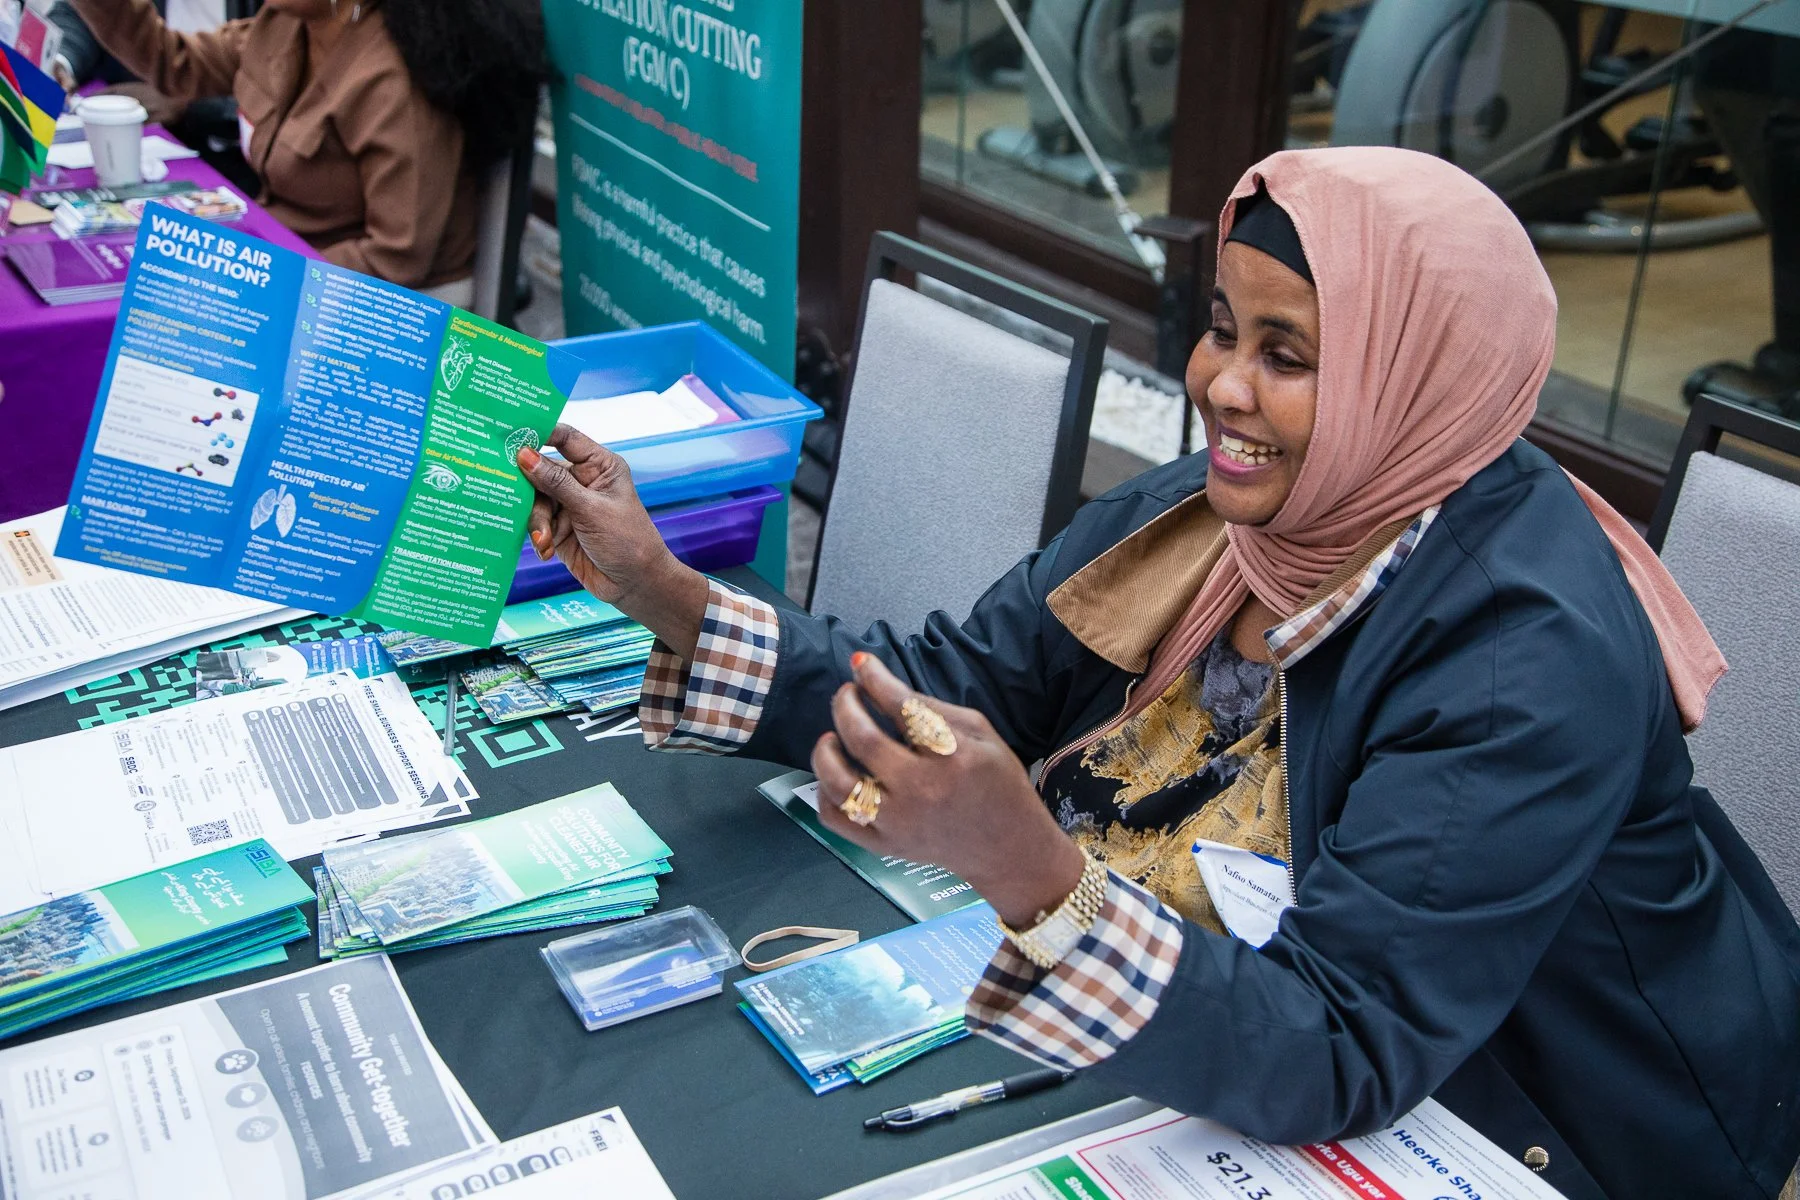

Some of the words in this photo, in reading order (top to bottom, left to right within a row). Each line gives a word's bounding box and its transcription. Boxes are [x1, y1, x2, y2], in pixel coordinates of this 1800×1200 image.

[152, 214, 215, 249] WHAT
[217, 238, 236, 257] IS
[238, 246, 272, 270] AIR
[146, 234, 270, 288] POLLUTION?
[140, 262, 188, 283] ACCORDING
[188, 277, 200, 286] TO
[201, 280, 217, 292] THE
[217, 286, 239, 298] WHO:
[724, 254, 767, 299] causes
[147, 277, 174, 291] pollution
[211, 298, 240, 312] presence
[128, 316, 180, 337] POLLUTANTS
[130, 307, 196, 333] UNDERSTANDING
[197, 328, 231, 343] CRITERIA
[232, 338, 246, 347] AIR
[450, 323, 477, 338] Diseases
[452, 316, 498, 339] Cardiovascular
[503, 337, 543, 357] Neurological
[300, 349, 318, 359] WHY
[478, 356, 491, 364] Heart
[492, 360, 512, 372] Disease
[472, 377, 497, 390] Long-term
[497, 386, 516, 398] Effects:
[516, 394, 540, 408] Increased
[473, 369, 495, 383] heartbeat,
[496, 378, 514, 390] fatigue,
[514, 386, 537, 398] dizziness
[504, 374, 518, 383] Chest
[518, 380, 530, 388] pain,
[530, 384, 551, 396] irregular
[474, 386, 485, 394] heart
[485, 391, 503, 401] attacks,
[504, 398, 520, 407] stroke
[268, 469, 315, 488] POLLUTION
[271, 460, 306, 476] HEALTH
[305, 470, 340, 485] EFFECTS
[340, 479, 352, 488] OF
[351, 482, 366, 491] AIR
[465, 474, 474, 482] Eye
[81, 495, 105, 508] MAIN
[105, 501, 146, 517] SOURCES
[308, 492, 349, 508] Respiratory
[349, 502, 379, 515] Diseases
[312, 501, 329, 511] from
[329, 506, 341, 514] Air
[341, 509, 371, 522] Pollution
[416, 492, 427, 500] Low
[426, 496, 439, 504] Birth
[459, 505, 484, 517] Pregnancy
[88, 509, 136, 525] Transportation
[135, 520, 167, 533] Emissions
[406, 520, 432, 532] Weakened
[451, 532, 469, 541] System
[251, 534, 275, 546] Chronic
[392, 546, 452, 568] TRANSPORTATION
[451, 562, 484, 576] EMISSIONS
[392, 555, 426, 569] Transportation
[426, 566, 450, 576] emissions
[238, 567, 254, 577] Lung
[254, 571, 276, 581] Cancer
[419, 579, 437, 588] harmful
[436, 576, 454, 584] vehicles
[454, 580, 471, 589] burning
[381, 583, 396, 592] These
[396, 588, 414, 597] include
[414, 593, 432, 601] criteria
[438, 600, 460, 608] pollutants
[468, 606, 486, 614] nitrogen
[411, 600, 436, 610] particulate
[464, 612, 479, 620] carbon
[363, 685, 375, 699] FREE
[369, 700, 383, 717] SMALL
[379, 717, 399, 744] BUSINESS
[393, 744, 413, 769] SUPPORT
[408, 770, 429, 799] SESSIONS
[125, 756, 138, 774] SBDC
[545, 815, 590, 855] CLEANER
[579, 853, 603, 869] AIR
[554, 805, 607, 853] SOLUTIONS
[596, 851, 622, 870] FOR
[574, 807, 630, 860] COMMUNITY
[521, 842, 550, 865] County
[556, 866, 576, 881] King
[902, 864, 934, 876] Foundation
[916, 873, 950, 886] Washington
[1224, 864, 1246, 883] Nafiso
[1247, 880, 1280, 903] Samatar
[296, 992, 310, 1000] A
[259, 1008, 273, 1026] Open
[299, 998, 320, 1030] moment
[266, 1026, 276, 1034] to
[388, 1033, 398, 1045] YOU
[272, 1042, 286, 1064] elders,
[310, 1029, 332, 1062] together
[392, 1043, 403, 1056] ARE
[324, 1062, 336, 1072] to
[328, 983, 374, 1058] Community
[359, 1057, 411, 1147] Get-together
[398, 1055, 412, 1076] INVITED
[300, 1061, 323, 1100] resources
[328, 1070, 345, 1093] learn
[289, 1090, 306, 1119] children,
[335, 1092, 355, 1116] about
[300, 1118, 313, 1133] and
[344, 1115, 372, 1163] community
[304, 1133, 325, 1169] neighbors
[1313, 1144, 1338, 1161] rka
[1336, 1160, 1364, 1182] Ugu
[1392, 1129, 1449, 1174] Heerke
[1449, 1176, 1482, 1200] Sha
[1206, 1151, 1272, 1200] $21.3
